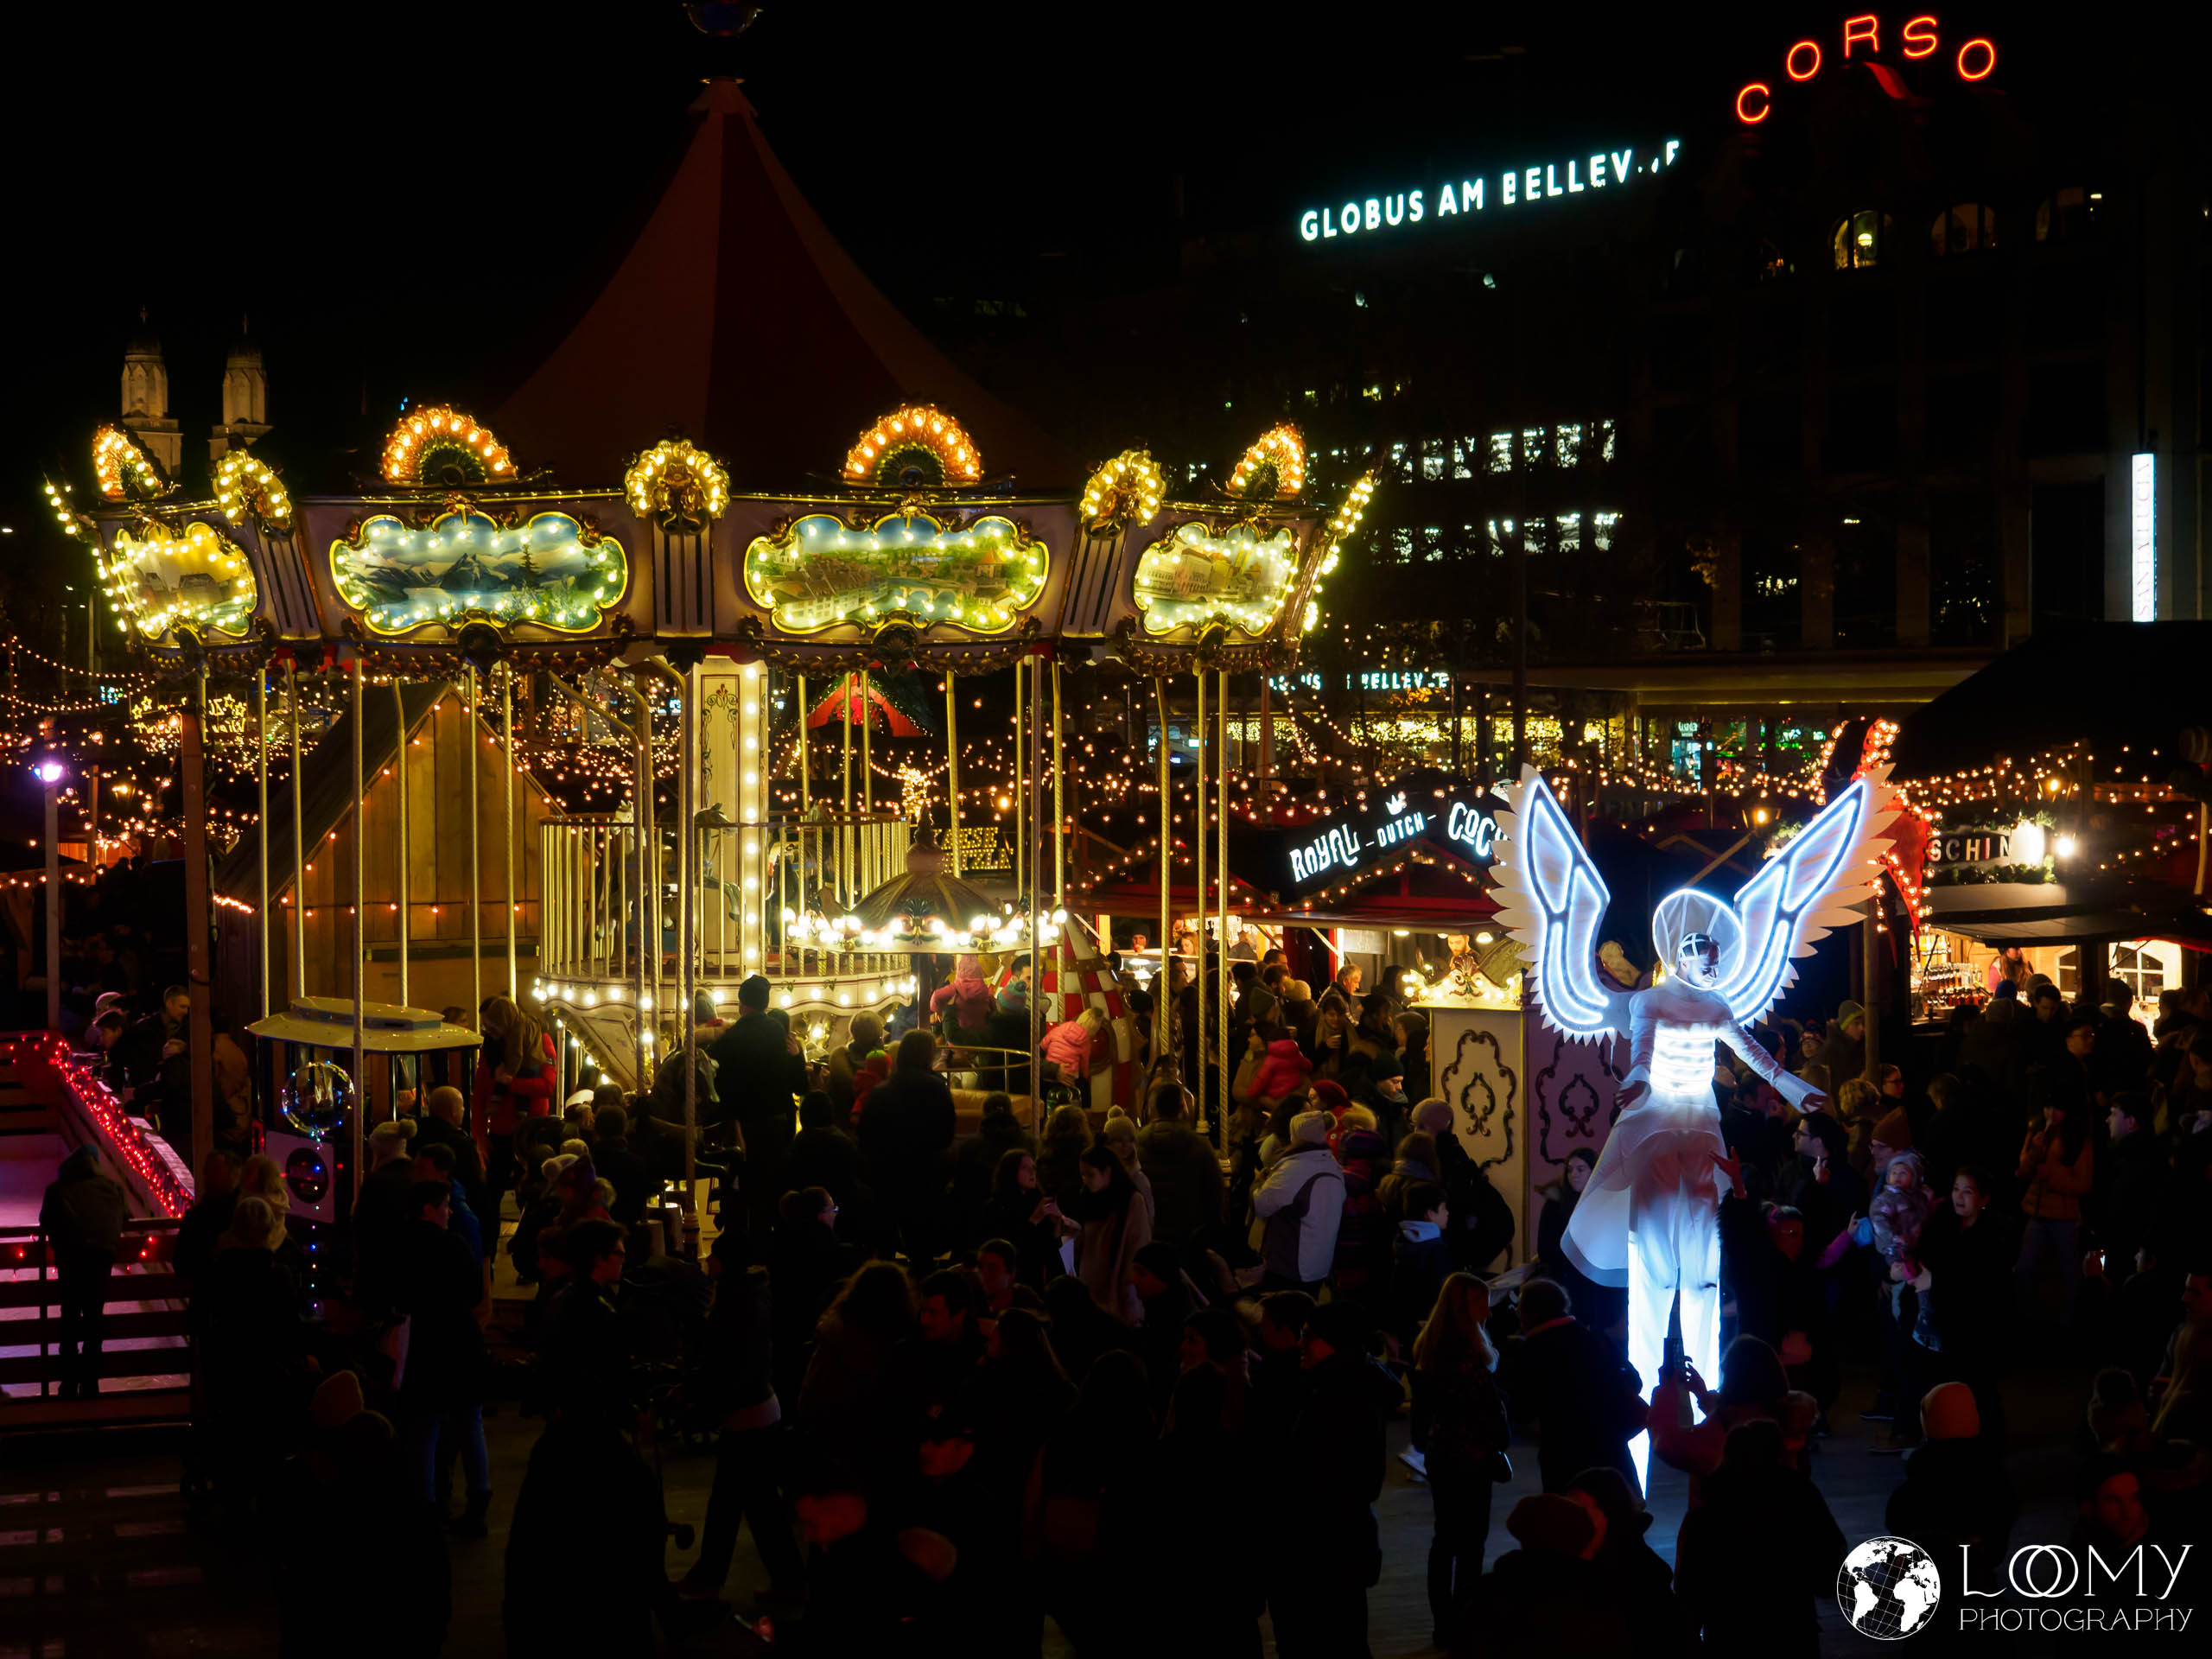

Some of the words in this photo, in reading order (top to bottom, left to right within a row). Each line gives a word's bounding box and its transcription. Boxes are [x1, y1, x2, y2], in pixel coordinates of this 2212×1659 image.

[1737, 15, 1995, 124] CORSO
[1300, 190, 1424, 242] GLOBUS
[1438, 178, 1484, 217] AM
[1503, 140, 1680, 206] BELLEVE
[1289, 823, 1361, 883] ROYAL
[1376, 810, 1425, 848] DUTCH
[1447, 802, 1509, 857] COC
